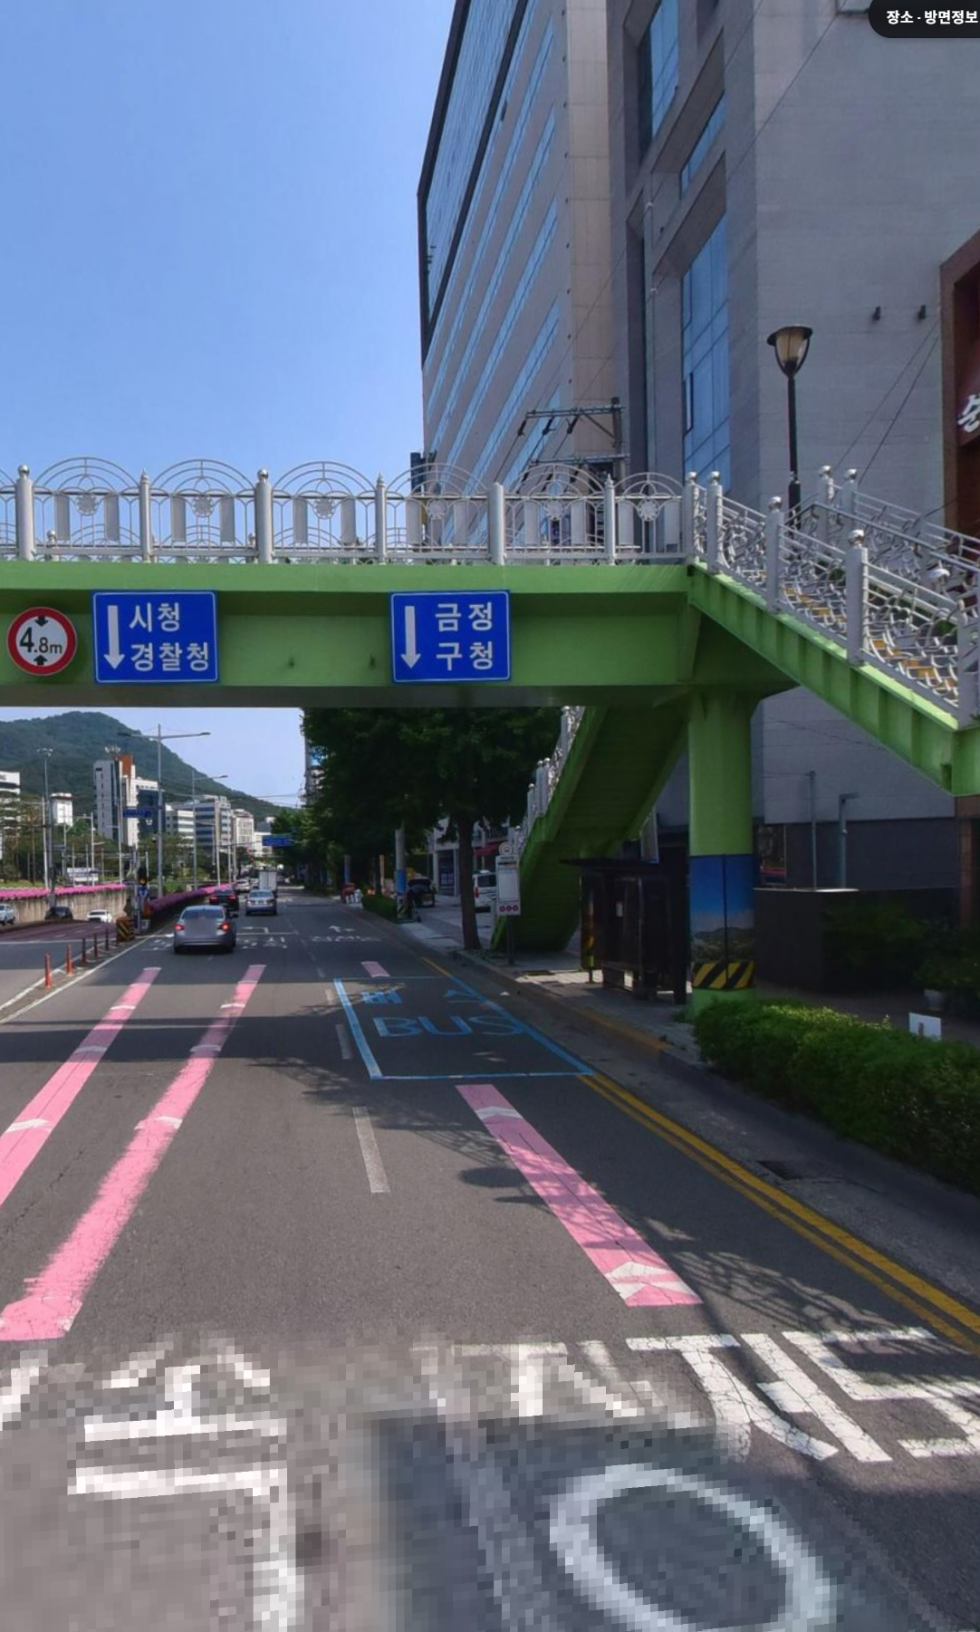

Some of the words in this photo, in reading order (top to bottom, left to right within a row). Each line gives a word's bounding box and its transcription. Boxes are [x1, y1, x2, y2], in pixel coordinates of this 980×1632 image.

[129, 602, 180, 633] 시청
[435, 601, 493, 632] 금정
[19, 626, 63, 654] 4.8m
[130, 641, 209, 672] 경찰청
[436, 641, 493, 672] 구청
[372, 1016, 524, 1038] BUS
